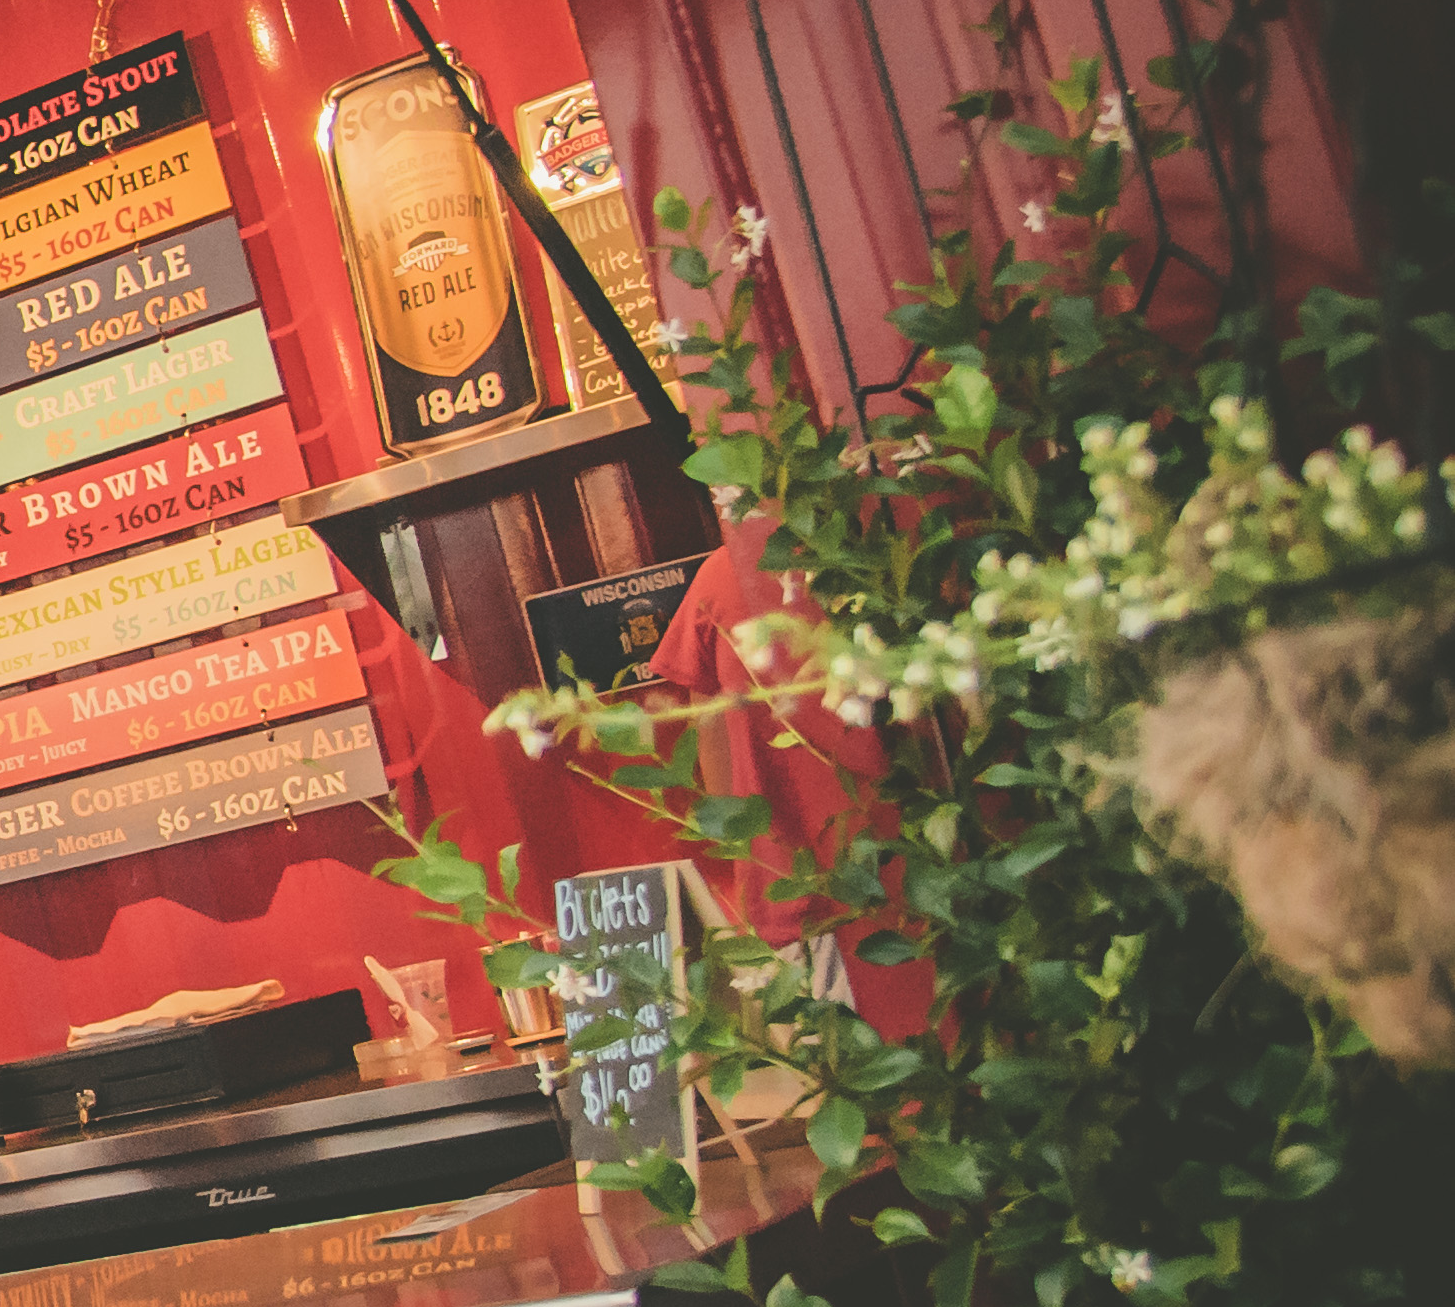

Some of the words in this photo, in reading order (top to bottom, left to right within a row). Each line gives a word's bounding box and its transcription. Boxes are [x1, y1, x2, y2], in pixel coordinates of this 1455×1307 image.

[83, 51, 178, 107] STOUT
[78, 106, 139, 147] CAN
[544, 132, 600, 165] BADGER
[83, 151, 190, 205] WHEAT
[115, 197, 174, 233] CAN
[17, 279, 101, 333] RED
[114, 244, 191, 301] ALE
[399, 281, 435, 313] RED
[443, 267, 476, 299] ALE
[403, 240, 455, 264] FORWARD
[26, 341, 58, 373] $5
[144, 287, 208, 325] CAN
[15, 374, 117, 429] CRAFT
[121, 339, 233, 395] LAGER
[46, 431, 77, 461] $5
[164, 379, 228, 416] CAN
[416, 372, 505, 427] 1848
[21, 460, 169, 528] BROWN
[186, 430, 263, 478] ALE
[65, 524, 94, 553] $5
[185, 477, 246, 510] CAN
[108, 559, 204, 607] STYLE
[208, 528, 317, 577] LAGER
[582, 568, 685, 607] WISCONSIN
[52, 636, 91, 661] DRY
[112, 615, 142, 644] $5
[234, 570, 298, 604] CAN
[69, 669, 193, 723] MANGO
[196, 650, 269, 688] TEA
[269, 623, 342, 667] IPA
[41, 739, 88, 765] JUICY
[127, 716, 159, 750] $6
[252, 677, 318, 712] CAN
[71, 771, 183, 817] COFFEE
[185, 740, 302, 792] BROWN
[309, 723, 372, 761] ALE
[56, 826, 127, 857] MOCHA
[158, 807, 190, 841] $6
[282, 770, 347, 805] CAN
